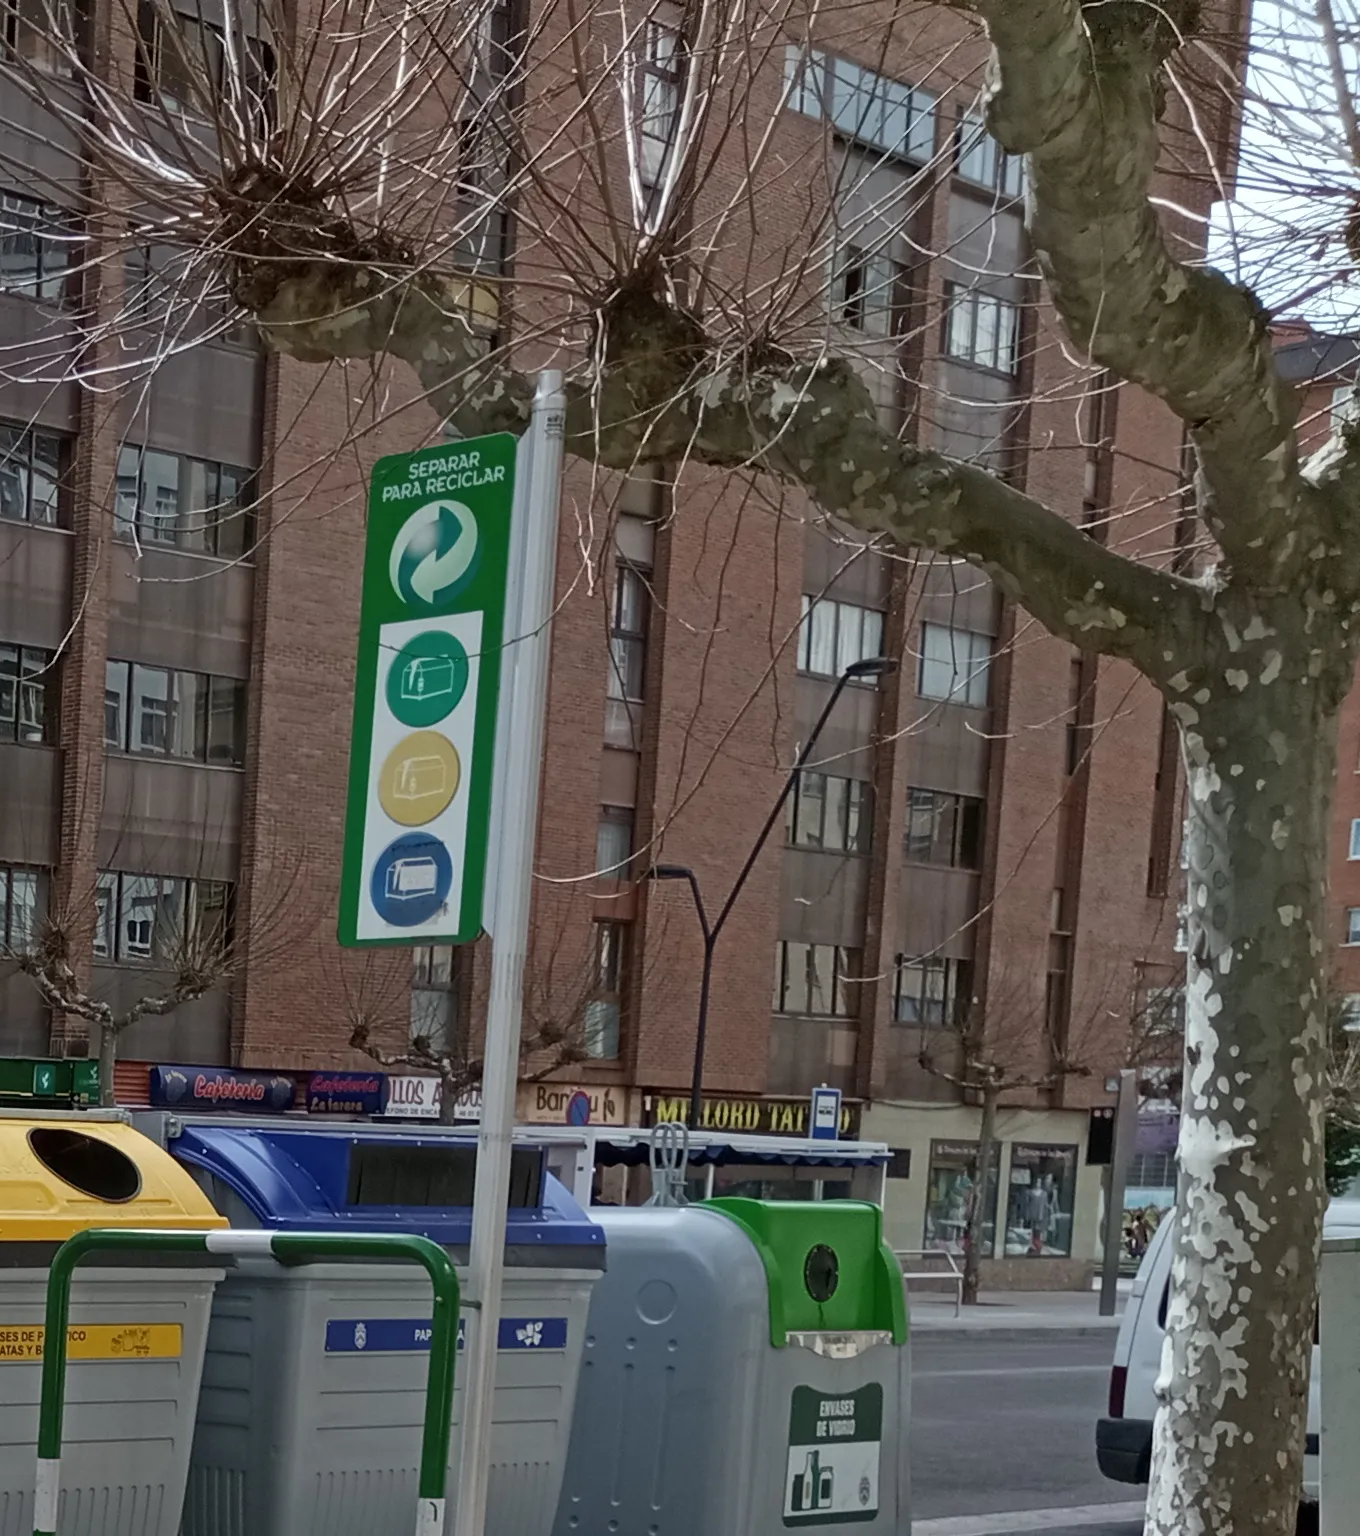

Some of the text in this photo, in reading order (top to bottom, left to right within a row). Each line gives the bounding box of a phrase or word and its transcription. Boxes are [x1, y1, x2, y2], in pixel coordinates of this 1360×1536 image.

[408, 451, 480, 480] SEPARAR
[382, 465, 506, 502] PARA RECICLAR
[656, 1097, 852, 1133] MILORD TATO
[21, 1331, 35, 1342] DE
[26, 1345, 33, 1356] Y
[819, 1399, 855, 1417] ENVASES
[816, 1419, 856, 1437] DE VIDRIO
